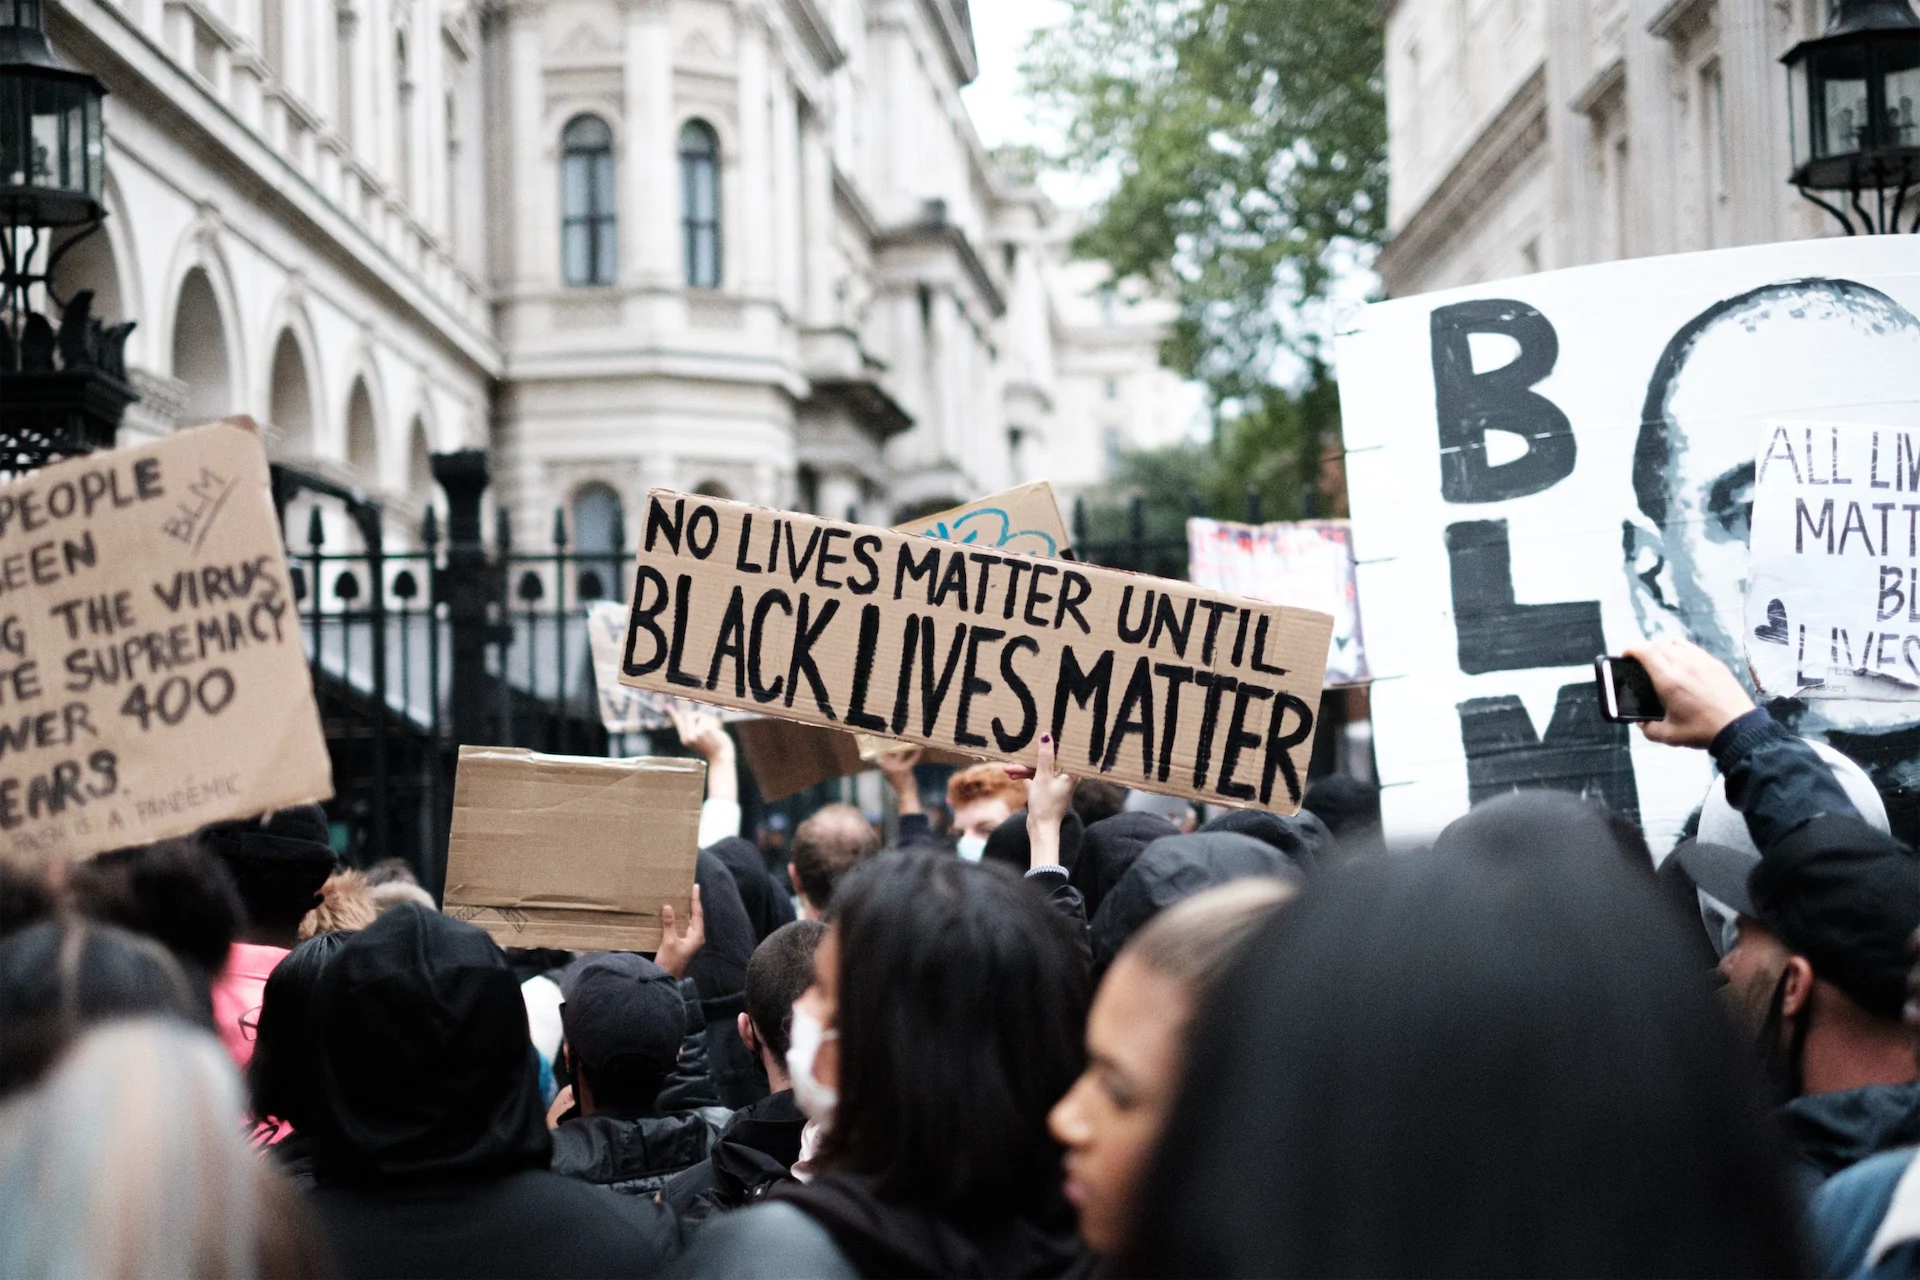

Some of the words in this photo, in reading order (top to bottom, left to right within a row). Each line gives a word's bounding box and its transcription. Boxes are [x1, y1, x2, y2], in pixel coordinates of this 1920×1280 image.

[1759, 426, 1852, 484] ALL
[0, 458, 164, 536] PEOPLE
[163, 467, 224, 544] BLM
[1796, 498, 1920, 557] MATT
[0, 531, 96, 591] EEN
[50, 590, 136, 640] THE
[154, 555, 280, 612] VIRUS
[645, 497, 718, 559] NO
[737, 514, 882, 594] LIVES
[893, 542, 1092, 633] MATTER
[1118, 585, 1291, 675] UNTIL
[65, 596, 286, 692] SUPREMACY
[120, 667, 235, 731] 400
[622, 565, 837, 720] BLACK
[844, 603, 1040, 752] LIVES
[1052, 645, 1313, 805] MATTER
